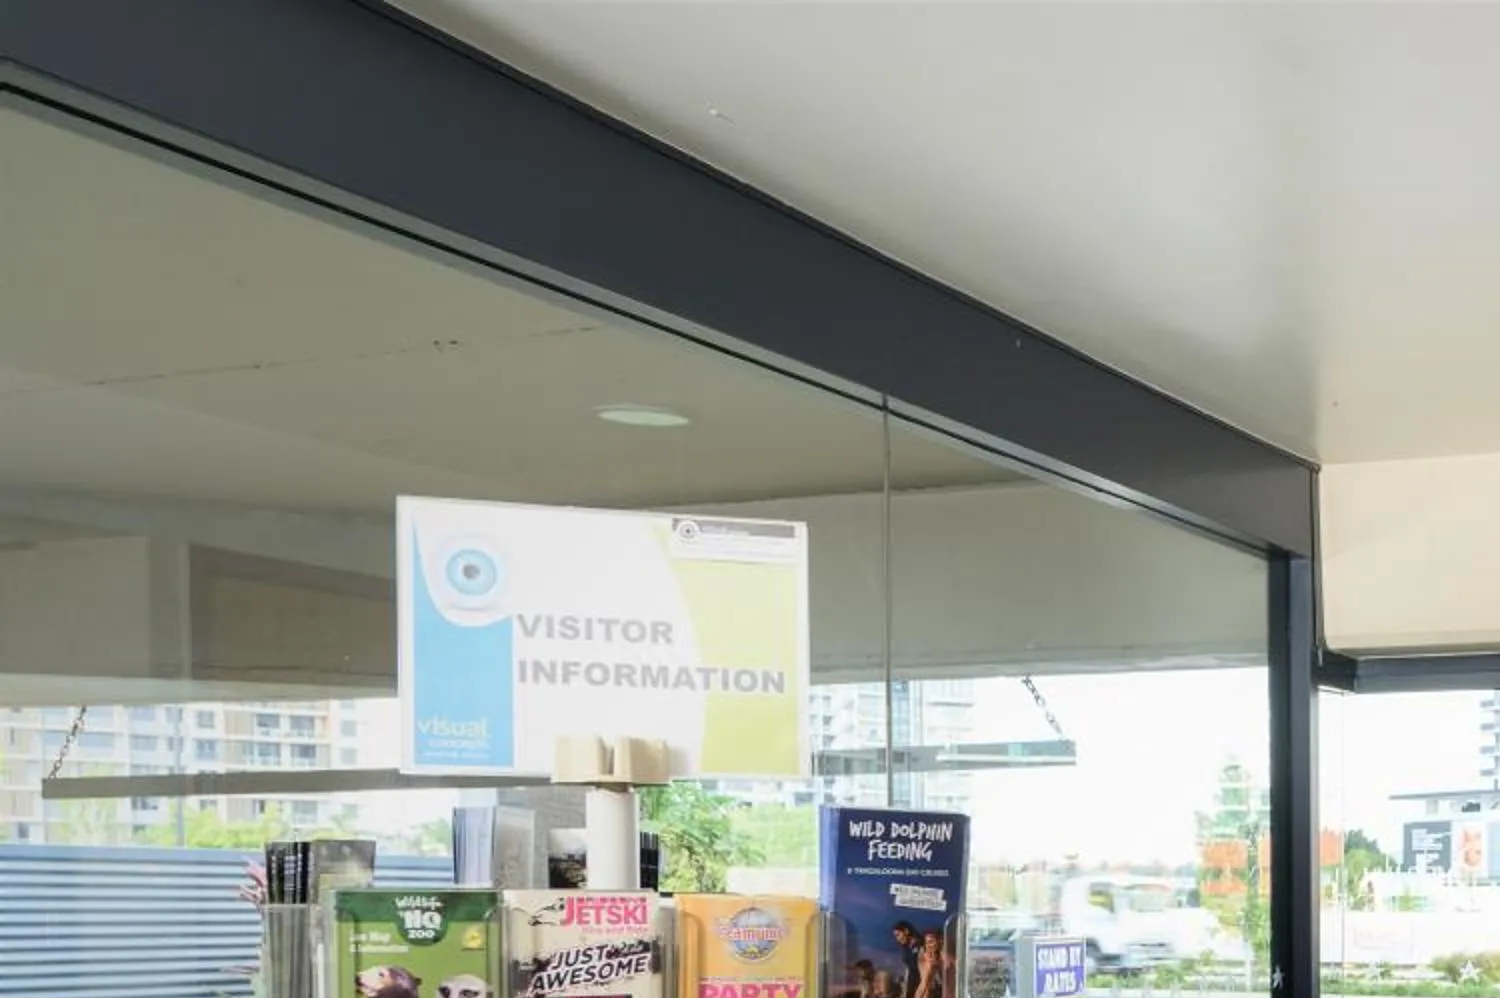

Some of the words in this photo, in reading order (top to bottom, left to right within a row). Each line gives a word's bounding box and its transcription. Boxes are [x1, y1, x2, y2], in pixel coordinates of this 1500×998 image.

[517, 613, 673, 645] VISITOR
[518, 658, 786, 694] INFORMATION
[849, 820, 885, 838] WILD
[890, 820, 953, 842] DOLPHIN
[868, 840, 933, 861] FEEDING
[560, 896, 648, 931] JETSKI
[551, 943, 608, 970] JUST
[531, 955, 649, 992] AWESOME
